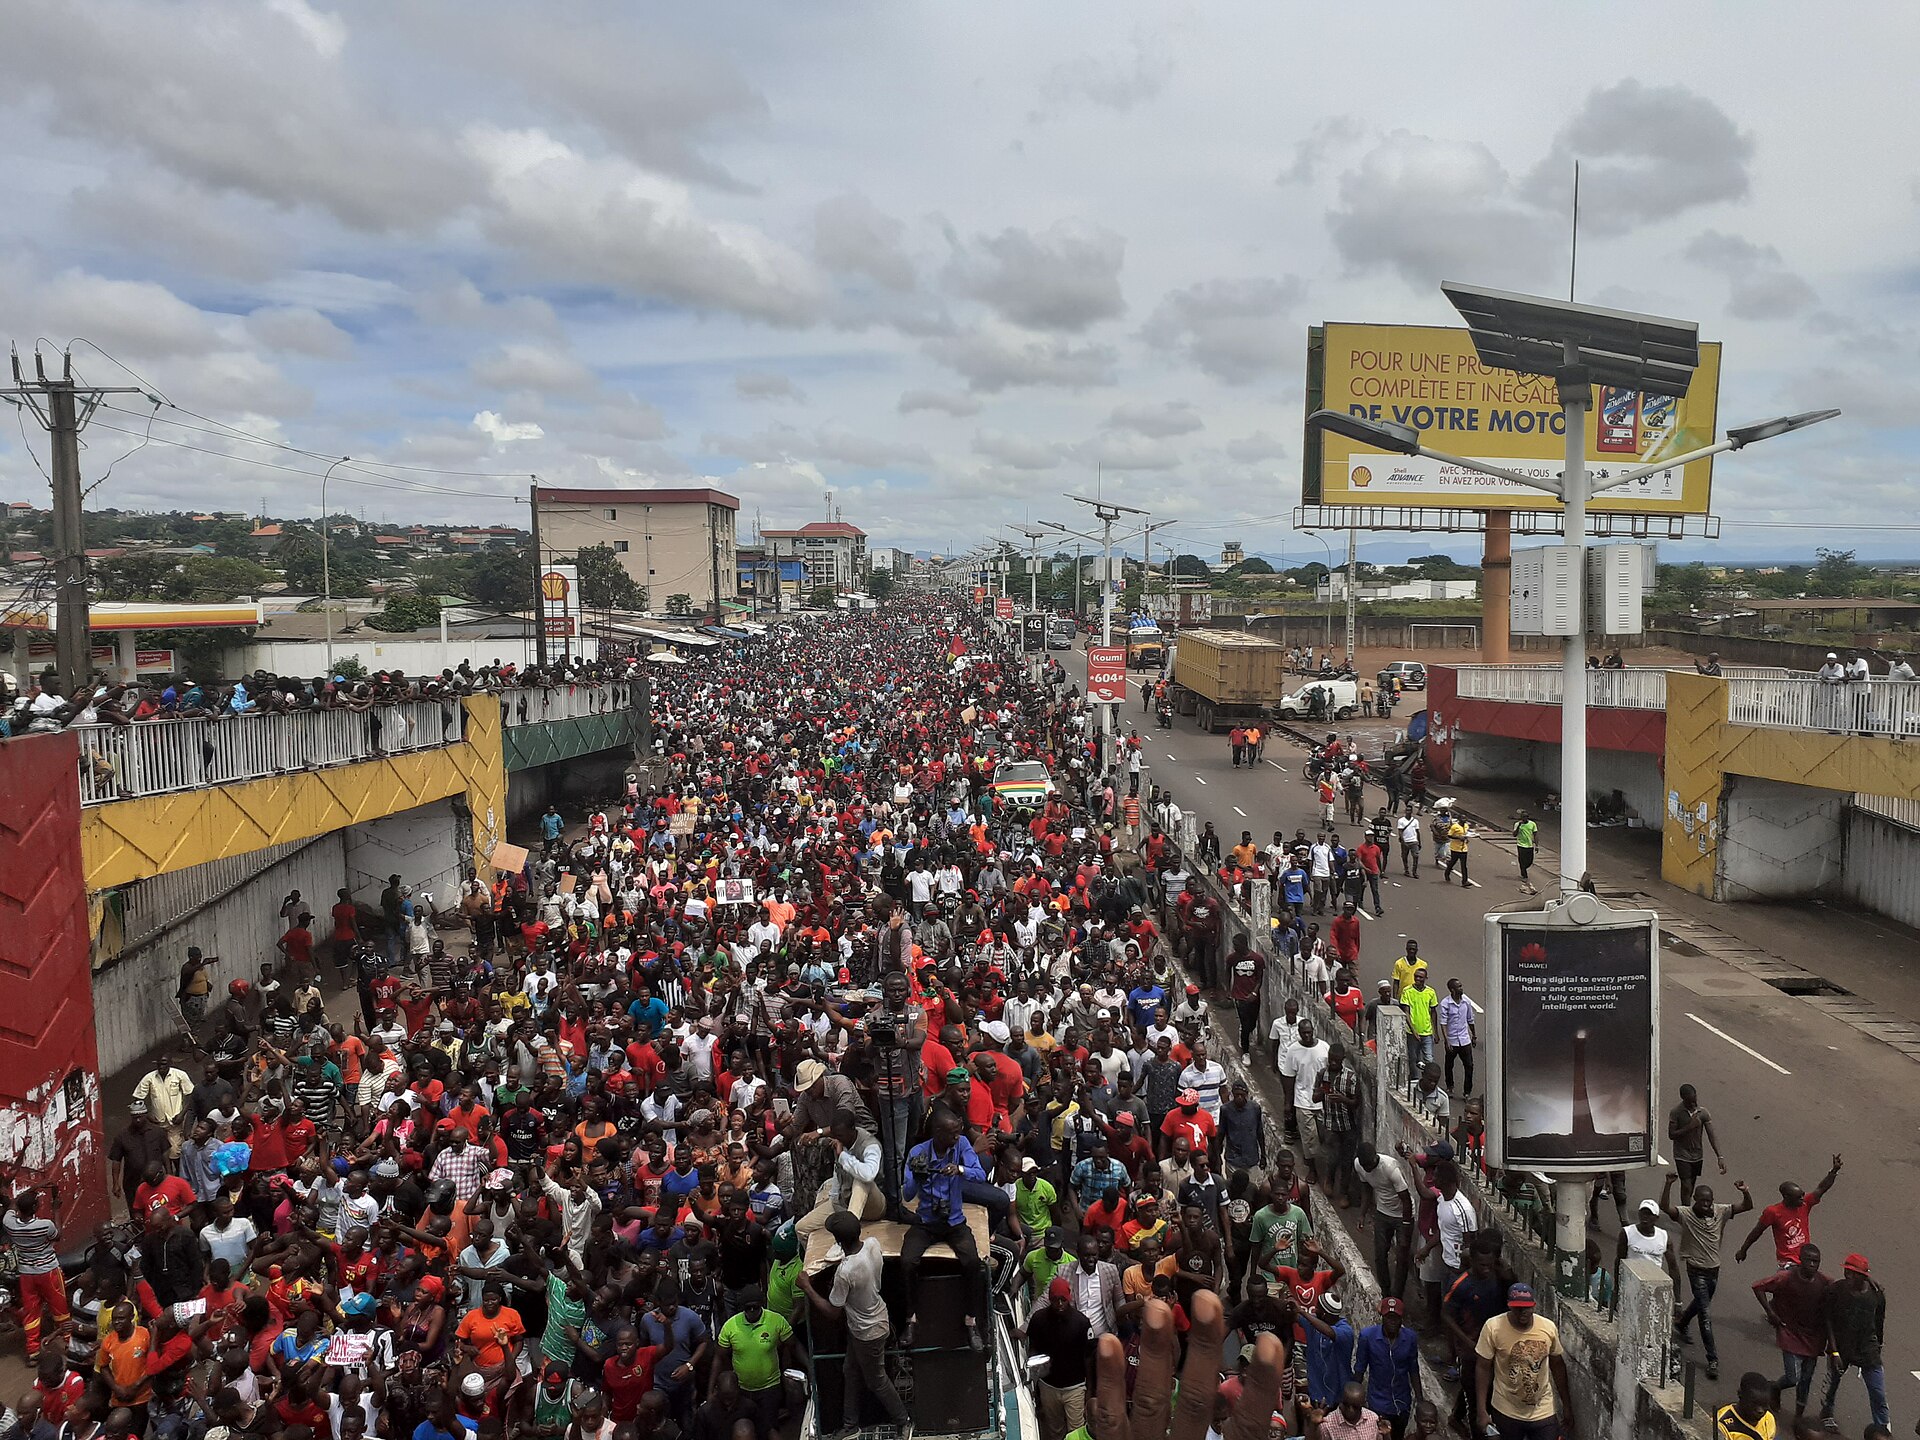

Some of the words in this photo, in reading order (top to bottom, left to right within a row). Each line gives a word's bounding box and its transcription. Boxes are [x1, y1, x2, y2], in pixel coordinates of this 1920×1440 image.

[1350, 350, 1403, 372] POUR
[1410, 353, 1450, 373] UNE
[1350, 374, 1449, 399] COMPLÈTE
[1456, 381, 1476, 400] ET
[1349, 404, 1381, 421] DE
[1391, 405, 1478, 431] VOTRE
[1488, 409, 1566, 434] MOTO
[1440, 466, 1460, 475] AVEC
[1527, 468, 1550, 477] VOUS
[1440, 476, 1450, 485] EN
[1453, 476, 1472, 485] AVEZ
[1474, 477, 1496, 486] POUR
[1028, 620, 1041, 629] 4G
[657, 890, 663, 899] 3
[1508, 975, 1547, 984] Bringing
[1549, 975, 1578, 984] digital
[1591, 975, 1615, 983] every
[1617, 974, 1647, 983] person,
[1568, 984, 1622, 993] organization
[1548, 994, 1568, 1002] fully
[1570, 993, 1619, 1001] connected,
[1542, 1002, 1587, 1011] intelligent
[1589, 1002, 1617, 1010] world.
